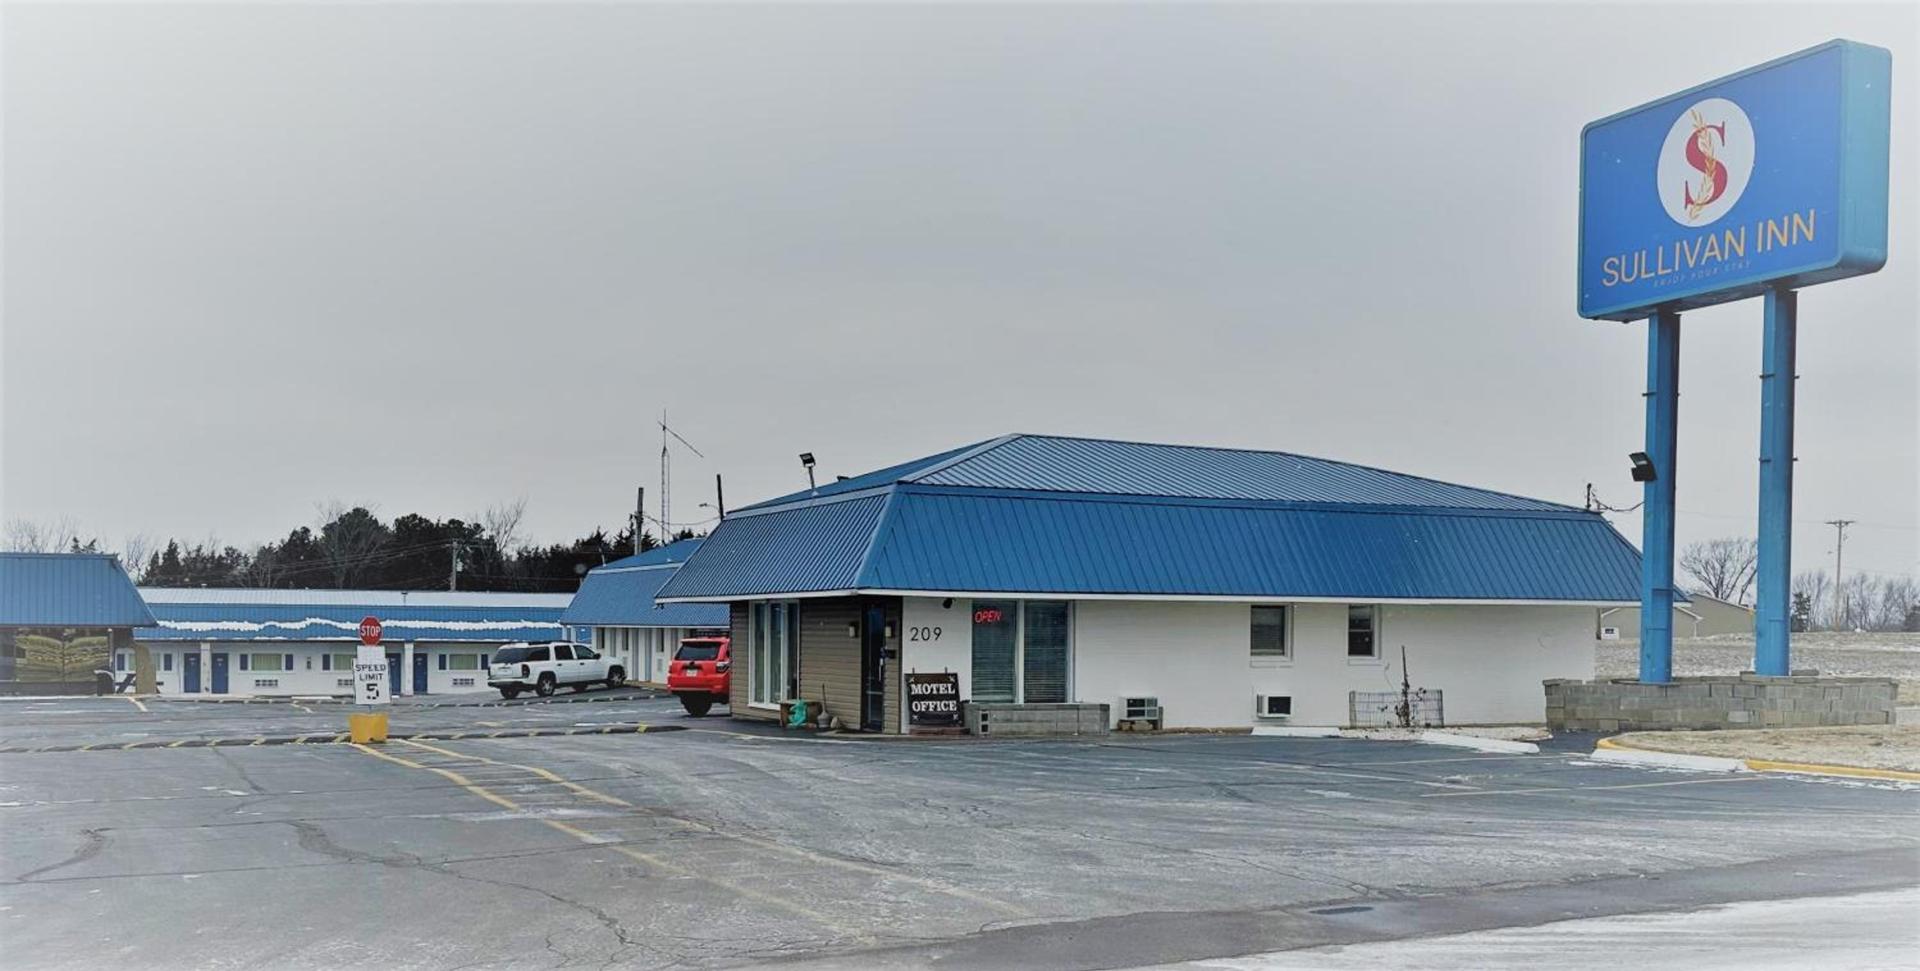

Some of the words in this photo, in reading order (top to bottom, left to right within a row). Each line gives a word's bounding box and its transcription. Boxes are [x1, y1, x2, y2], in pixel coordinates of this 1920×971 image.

[1684, 121, 1728, 210] S
[1602, 225, 1746, 287] SULLIVAN
[1756, 208, 1816, 253] INN
[974, 610, 1002, 623] OPEN
[360, 625, 381, 637] STOP
[909, 626, 943, 641] 209
[355, 664, 386, 672] SPEED
[359, 673, 384, 681] LIMIT
[365, 683, 380, 700] 5
[910, 682, 956, 695] MOTEL
[911, 700, 958, 712] OFFICE
